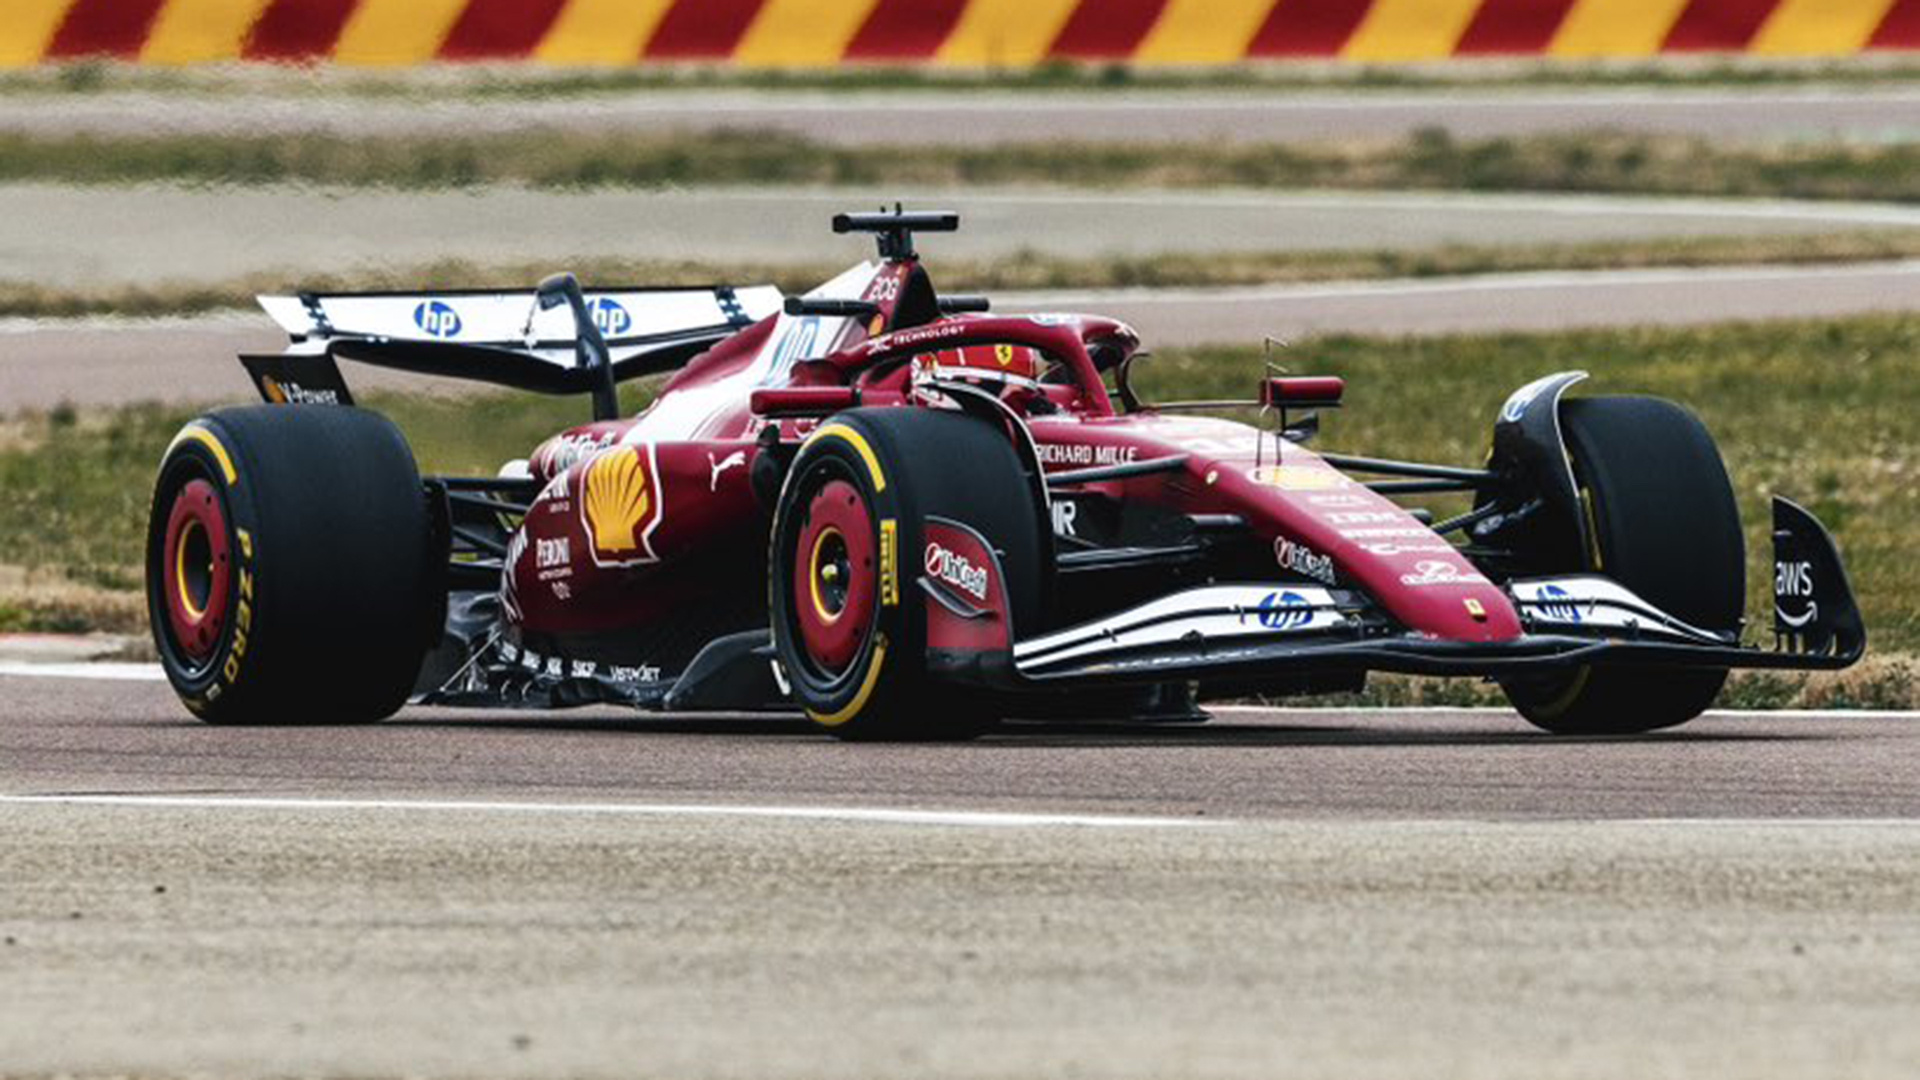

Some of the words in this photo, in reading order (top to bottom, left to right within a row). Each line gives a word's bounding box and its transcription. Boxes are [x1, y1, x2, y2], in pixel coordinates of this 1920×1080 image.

[414, 301, 462, 337] hp
[1035, 444, 1092, 464] RICHARD
[1095, 446, 1137, 464] MILLE
[1775, 560, 1813, 597] aws
